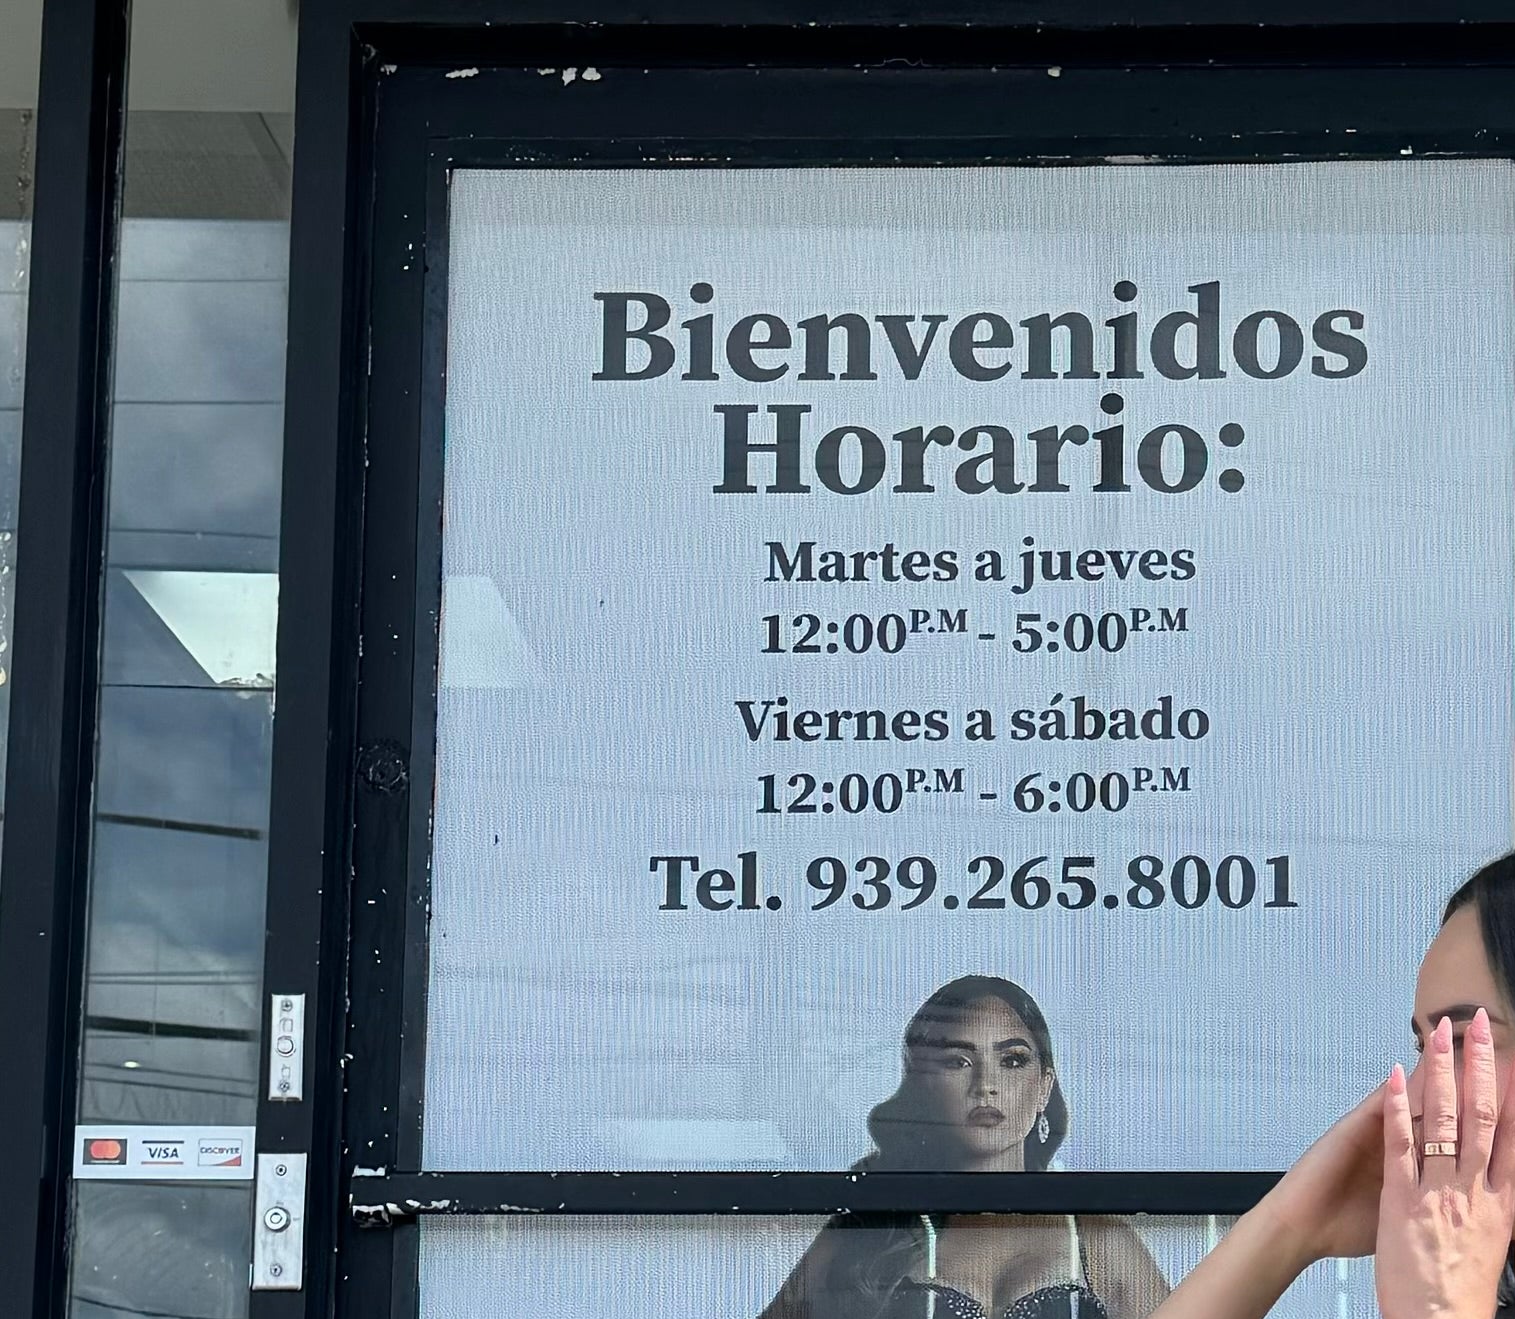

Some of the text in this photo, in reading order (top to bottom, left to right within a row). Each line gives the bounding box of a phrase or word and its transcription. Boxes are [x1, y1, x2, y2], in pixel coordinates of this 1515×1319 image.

[592, 280, 1368, 383] Bienvenidos
[712, 393, 1246, 496] Horario:
[764, 536, 1197, 595] Martes a jueves
[735, 694, 1210, 743] Viernes a sábado
[649, 851, 1298, 911] Tel. 939.265.8001
[148, 1147, 180, 1158] VISA
